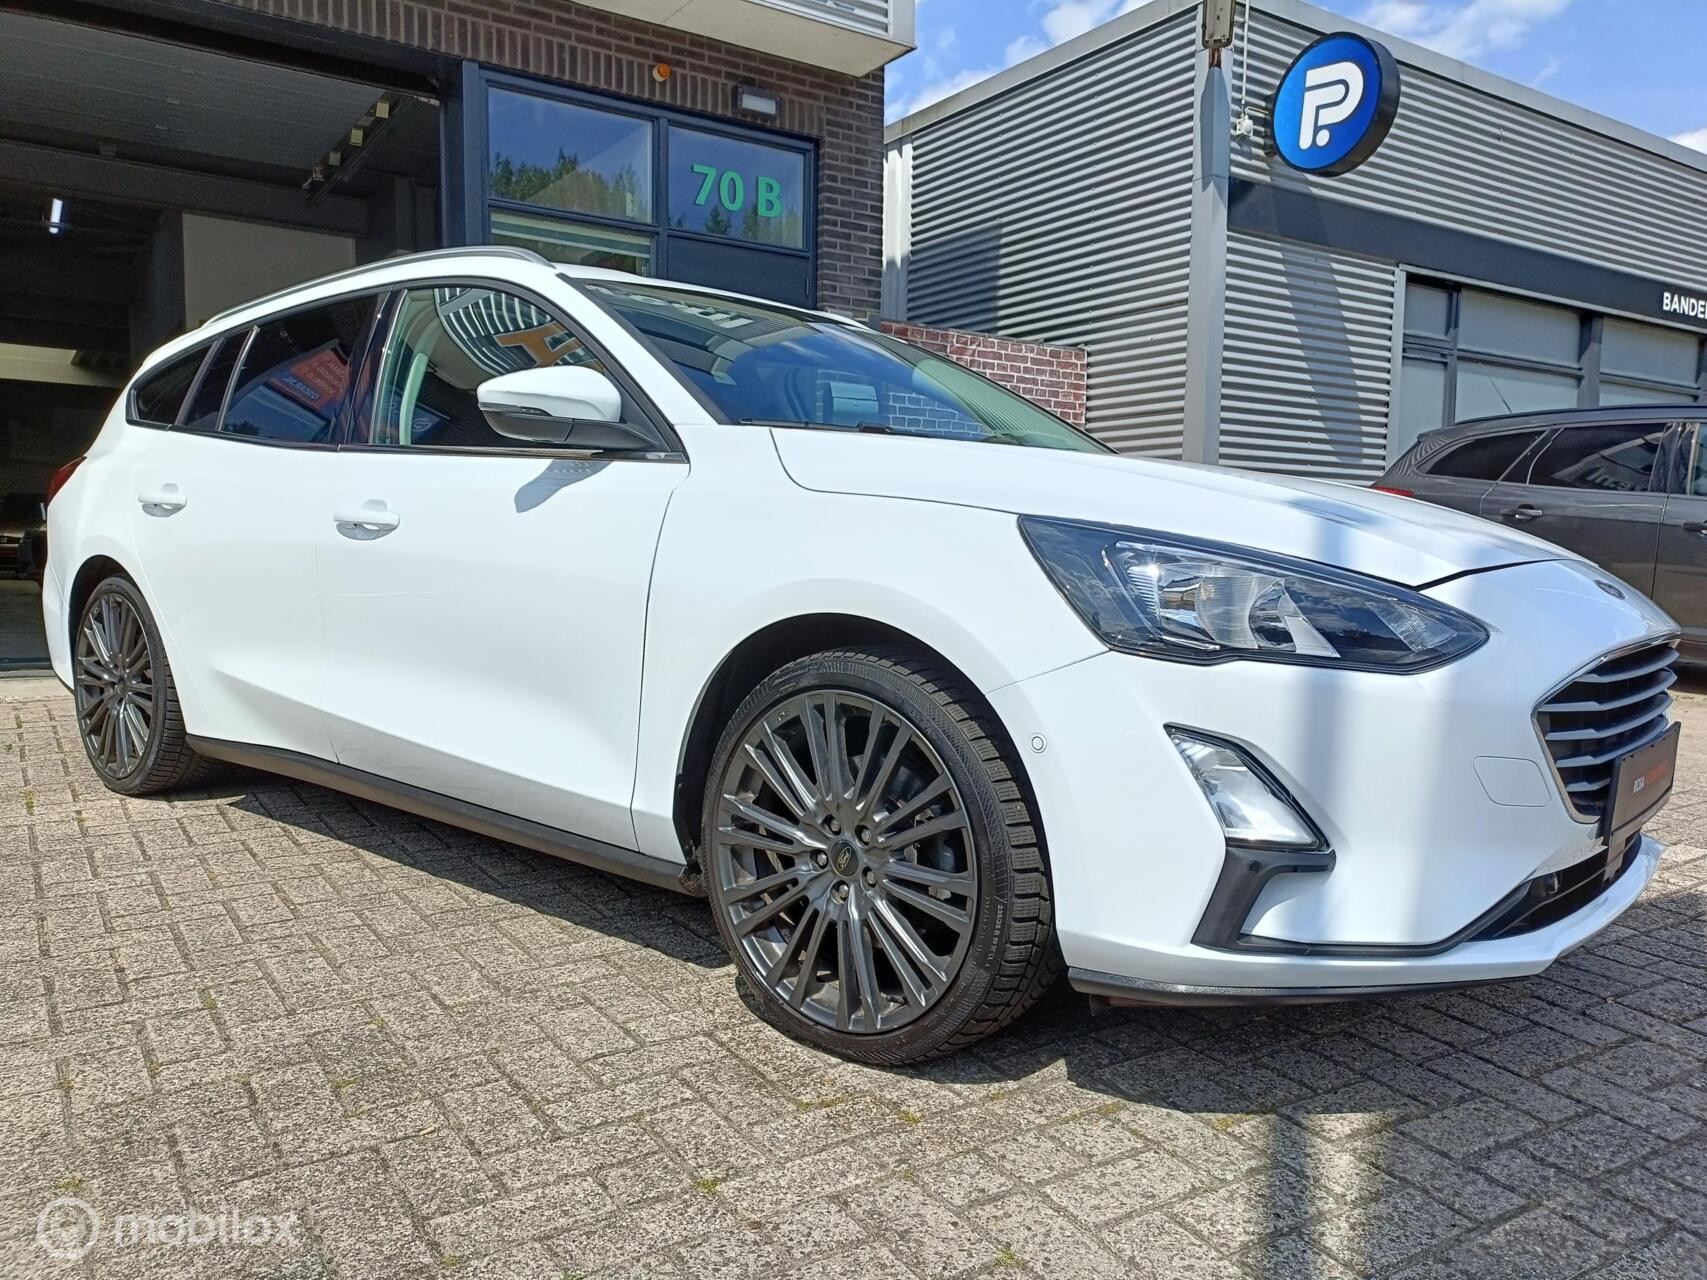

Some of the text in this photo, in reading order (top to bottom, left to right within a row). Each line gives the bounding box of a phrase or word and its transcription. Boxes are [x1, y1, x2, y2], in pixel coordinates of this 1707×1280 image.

[691, 163, 782, 218] 70 B
[1662, 290, 1707, 320] BANDE
